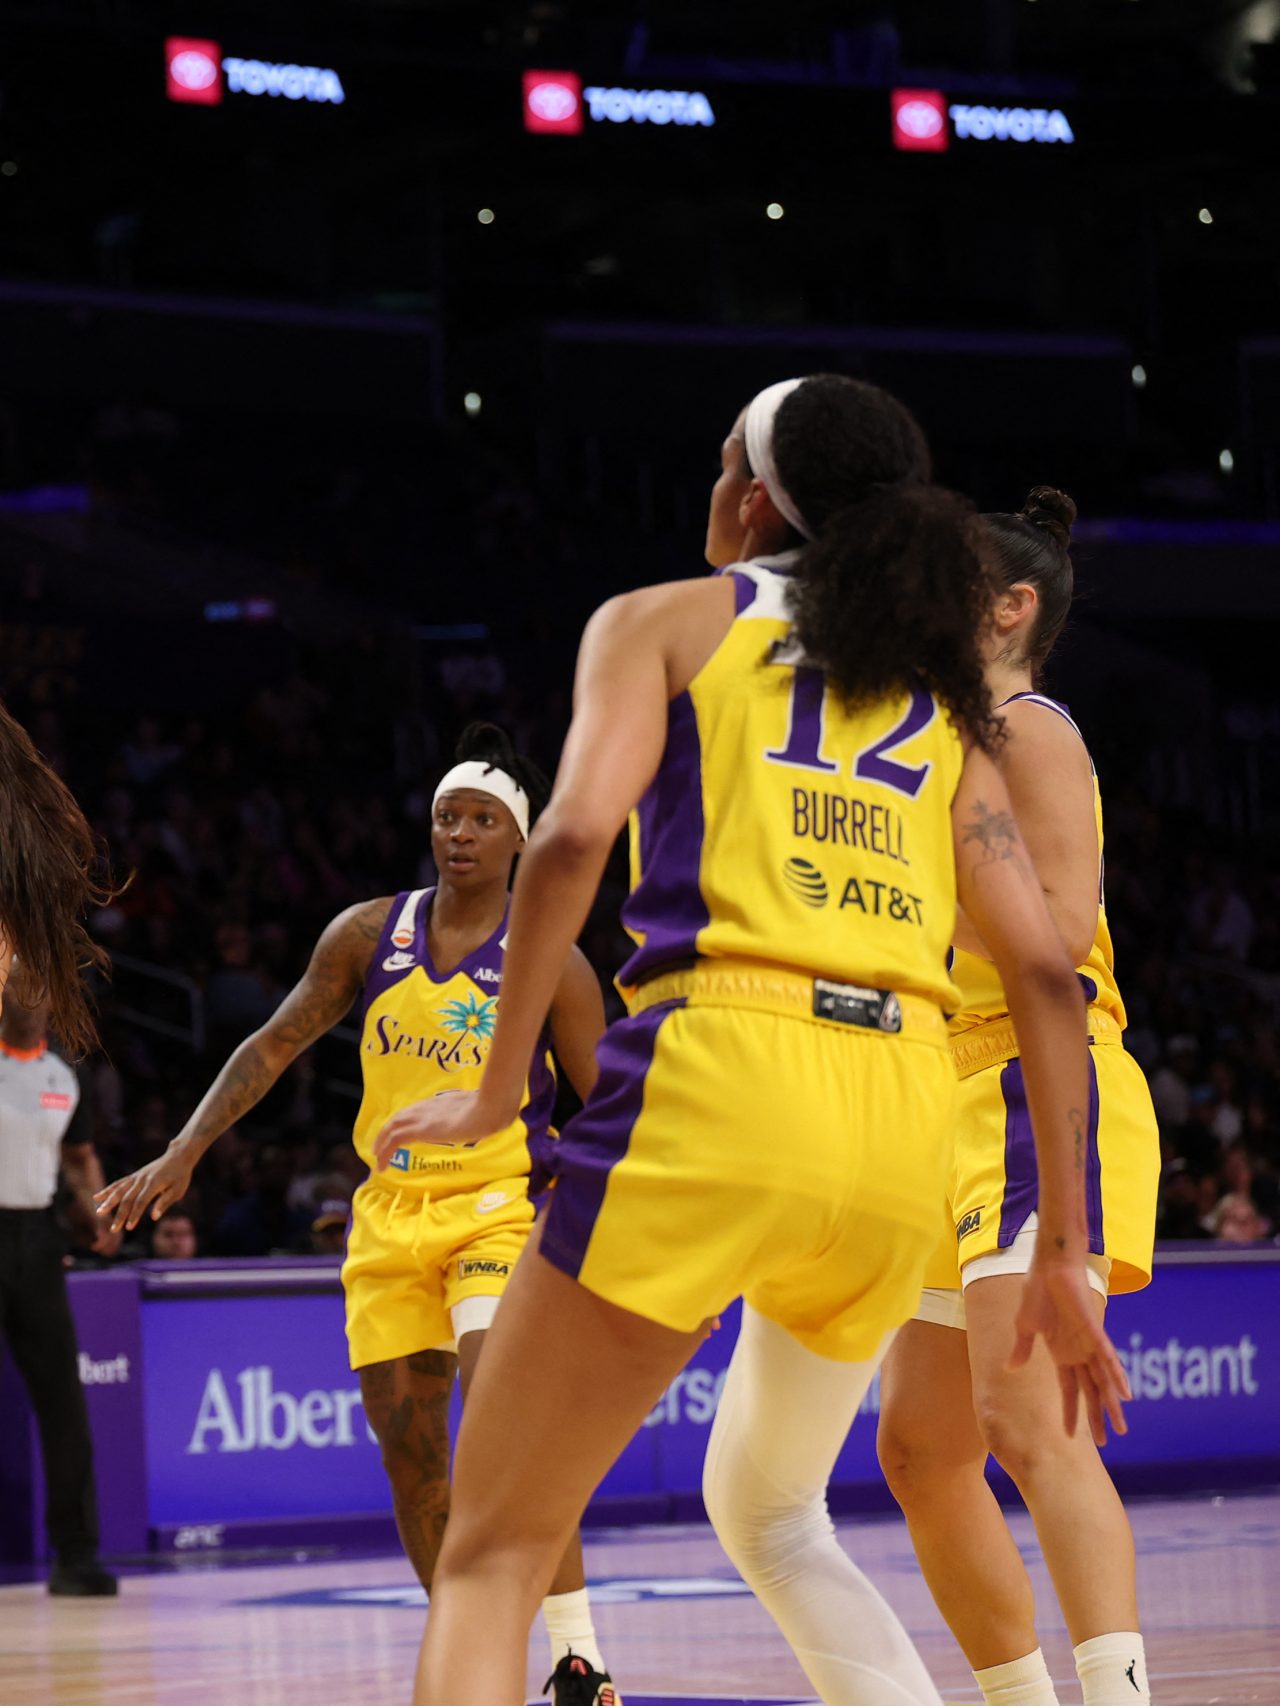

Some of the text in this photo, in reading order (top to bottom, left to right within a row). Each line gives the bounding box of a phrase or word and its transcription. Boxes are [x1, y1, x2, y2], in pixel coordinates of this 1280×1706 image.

[224, 59, 343, 101] TOYOTA
[586, 88, 713, 124] TOYOTA
[952, 106, 1072, 141] TOYOTA
[793, 787, 910, 866] BURRELL
[839, 877, 923, 926] AT&T
[367, 1014, 488, 1073] SPARKS
[412, 1155, 462, 1172] Health
[463, 1261, 509, 1276] WNBA
